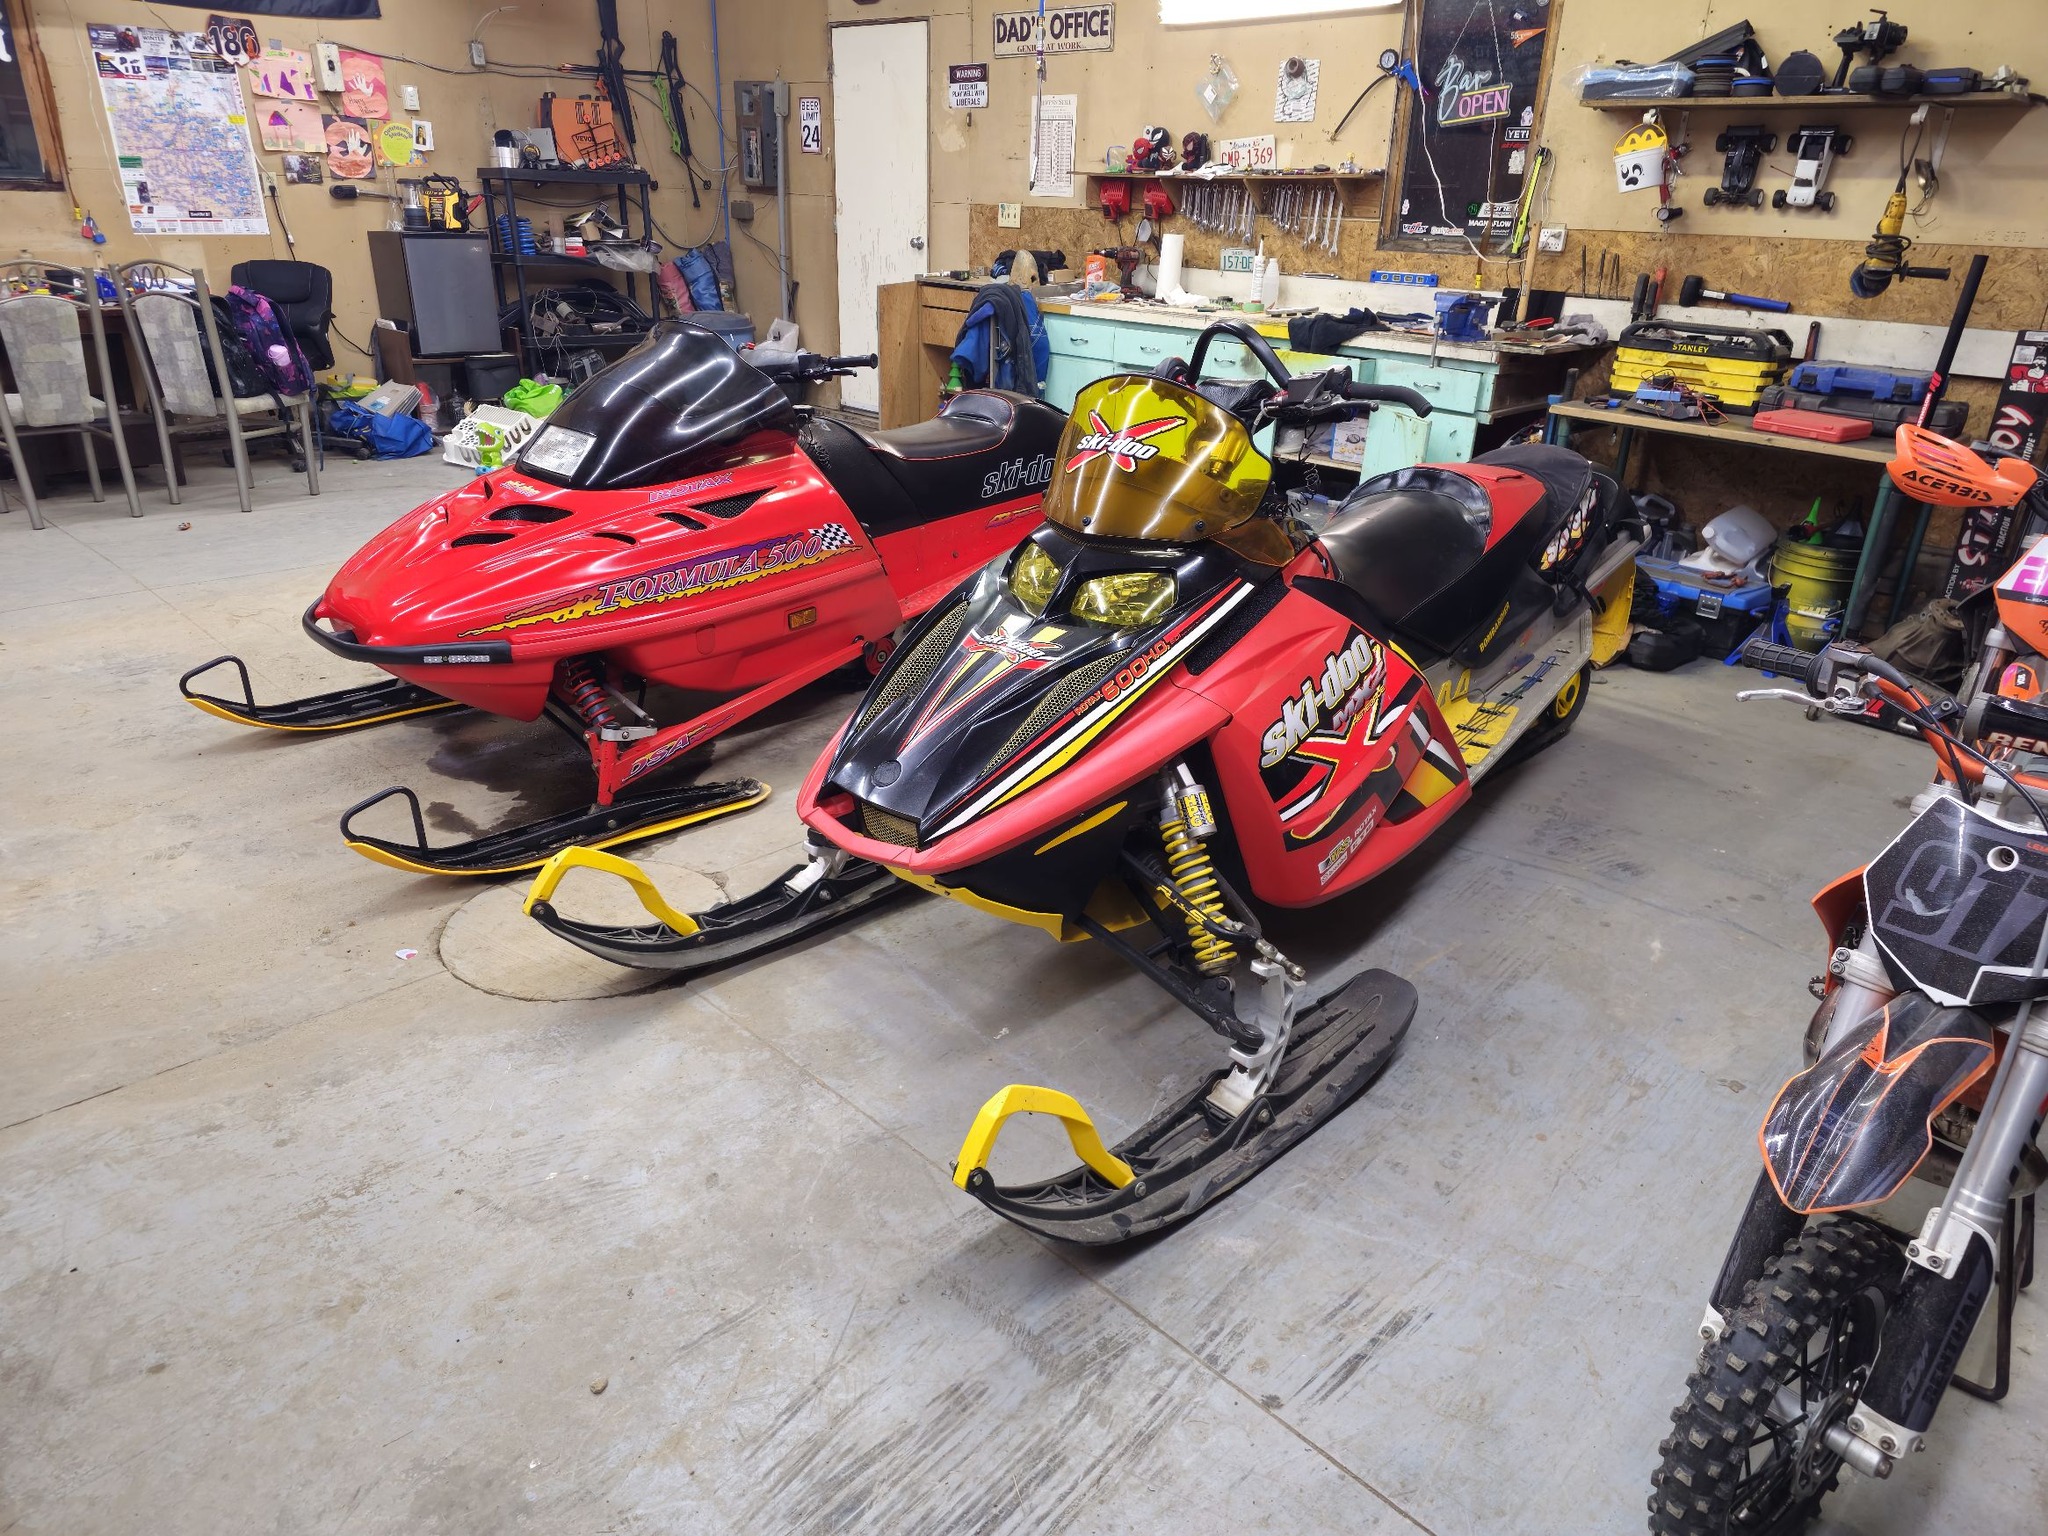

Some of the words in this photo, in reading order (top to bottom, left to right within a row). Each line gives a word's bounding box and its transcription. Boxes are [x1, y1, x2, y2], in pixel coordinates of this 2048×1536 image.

[1050, 10, 1109, 40] OFFICE
[207, 25, 260, 58] 186
[1017, 44, 1042, 53] GENI
[1046, 43, 1055, 51] AT
[956, 69, 982, 79] WARNING
[1435, 55, 1492, 121] Bar
[801, 101, 819, 111] BEER
[957, 98, 981, 106] LIBERALS
[1459, 89, 1507, 118] OPEN
[803, 112, 819, 121] LIMIT
[575, 135, 593, 143] VEVO
[802, 125, 820, 148] 24
[1508, 130, 1530, 139] YETI
[1468, 219, 1512, 228] MAGNFLOW
[1223, 256, 1254, 271] 157-DF
[1672, 343, 1709, 354] STANLEY
[1988, 404, 2035, 450] OY
[1076, 433, 1160, 460] ski-doo
[649, 473, 733, 503] ROTAX
[981, 454, 1057, 499] ski-do
[1902, 470, 1993, 503] ACERBIS
[596, 549, 761, 610] FORMULA
[765, 535, 823, 569] 500
[1952, 563, 1961, 574] BY
[1261, 633, 1374, 768] ski-doo
[622, 733, 690, 782] DSA
[1920, 1288, 1980, 1406] RENTHAL
